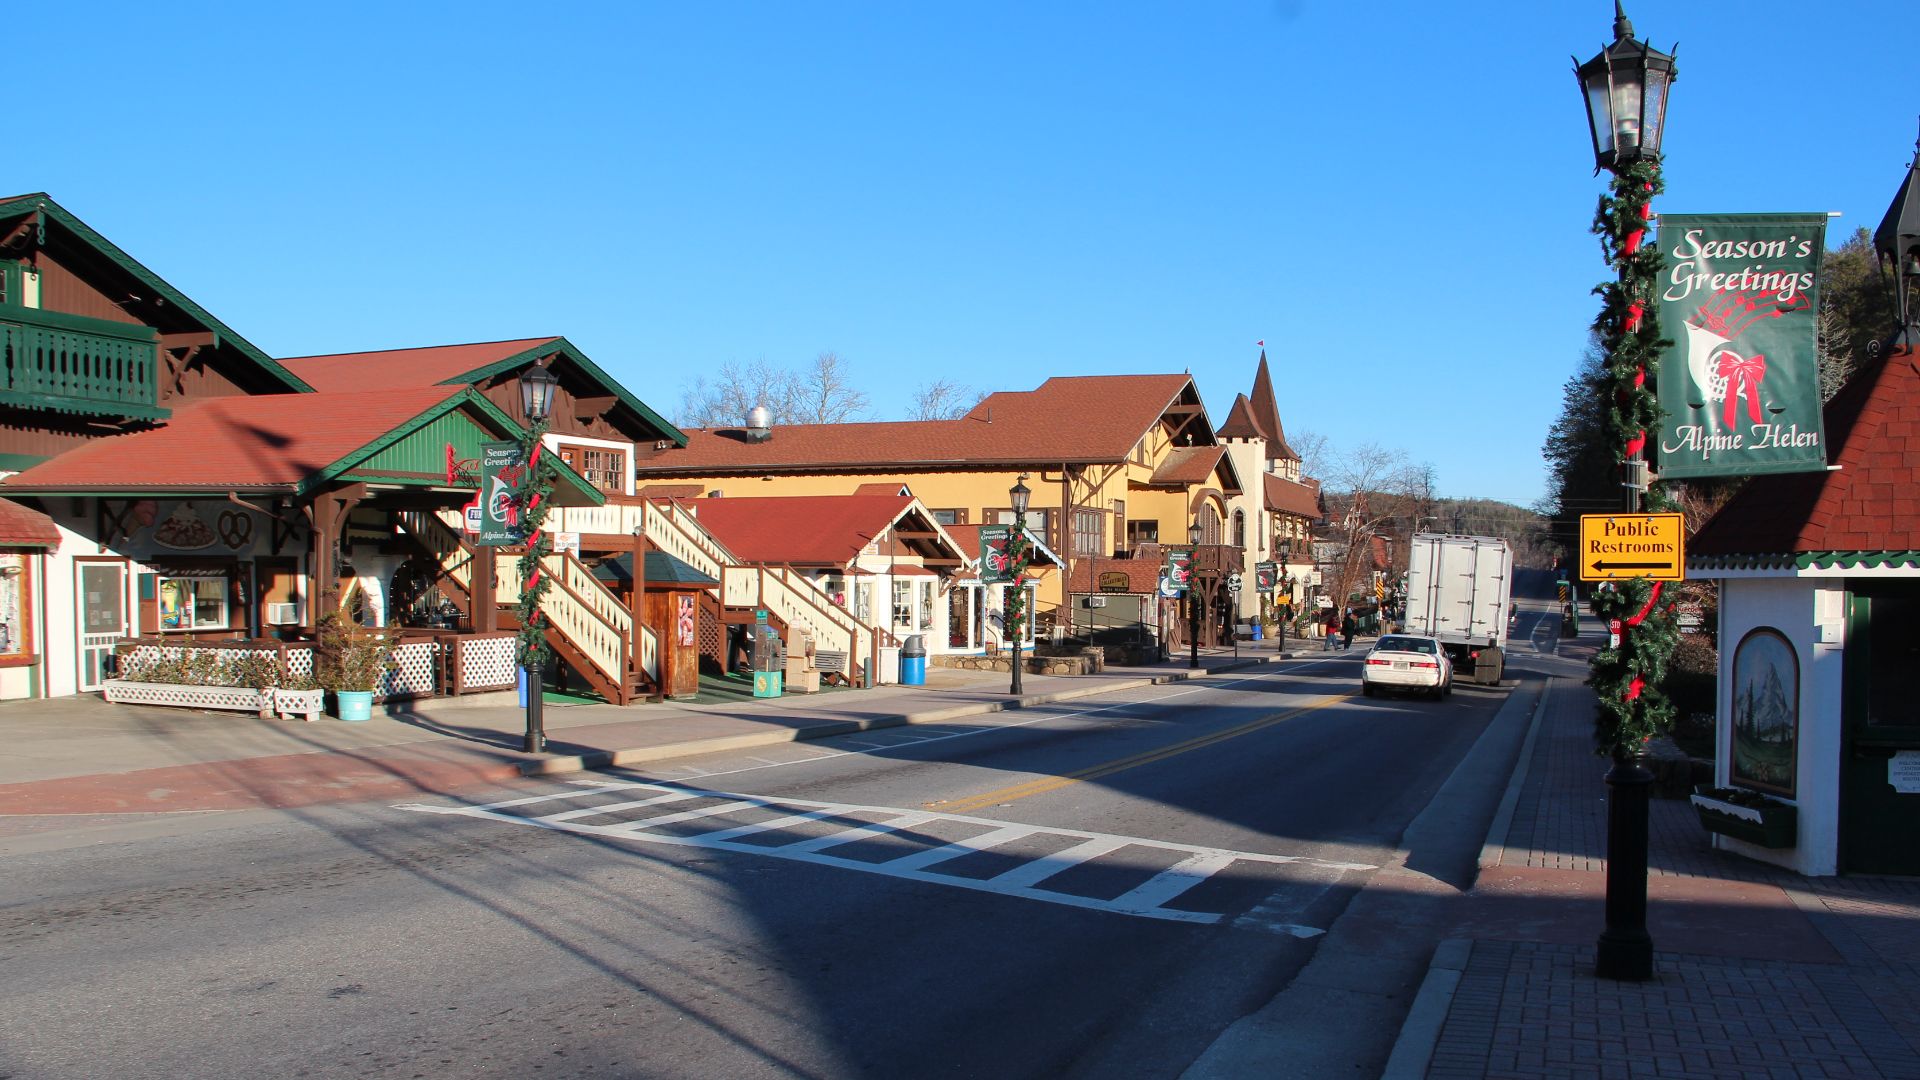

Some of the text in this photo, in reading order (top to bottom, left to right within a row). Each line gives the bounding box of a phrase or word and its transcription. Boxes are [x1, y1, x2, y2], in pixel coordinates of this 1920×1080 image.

[1672, 229, 1812, 259] Season's
[1662, 261, 1814, 302] Greetings
[1662, 424, 1819, 461] Alpine Helen
[482, 531, 504, 541] Alpine
[1604, 521, 1659, 537] Public
[1589, 539, 1674, 554] Restrooms
[1611, 620, 1620, 628] STO
